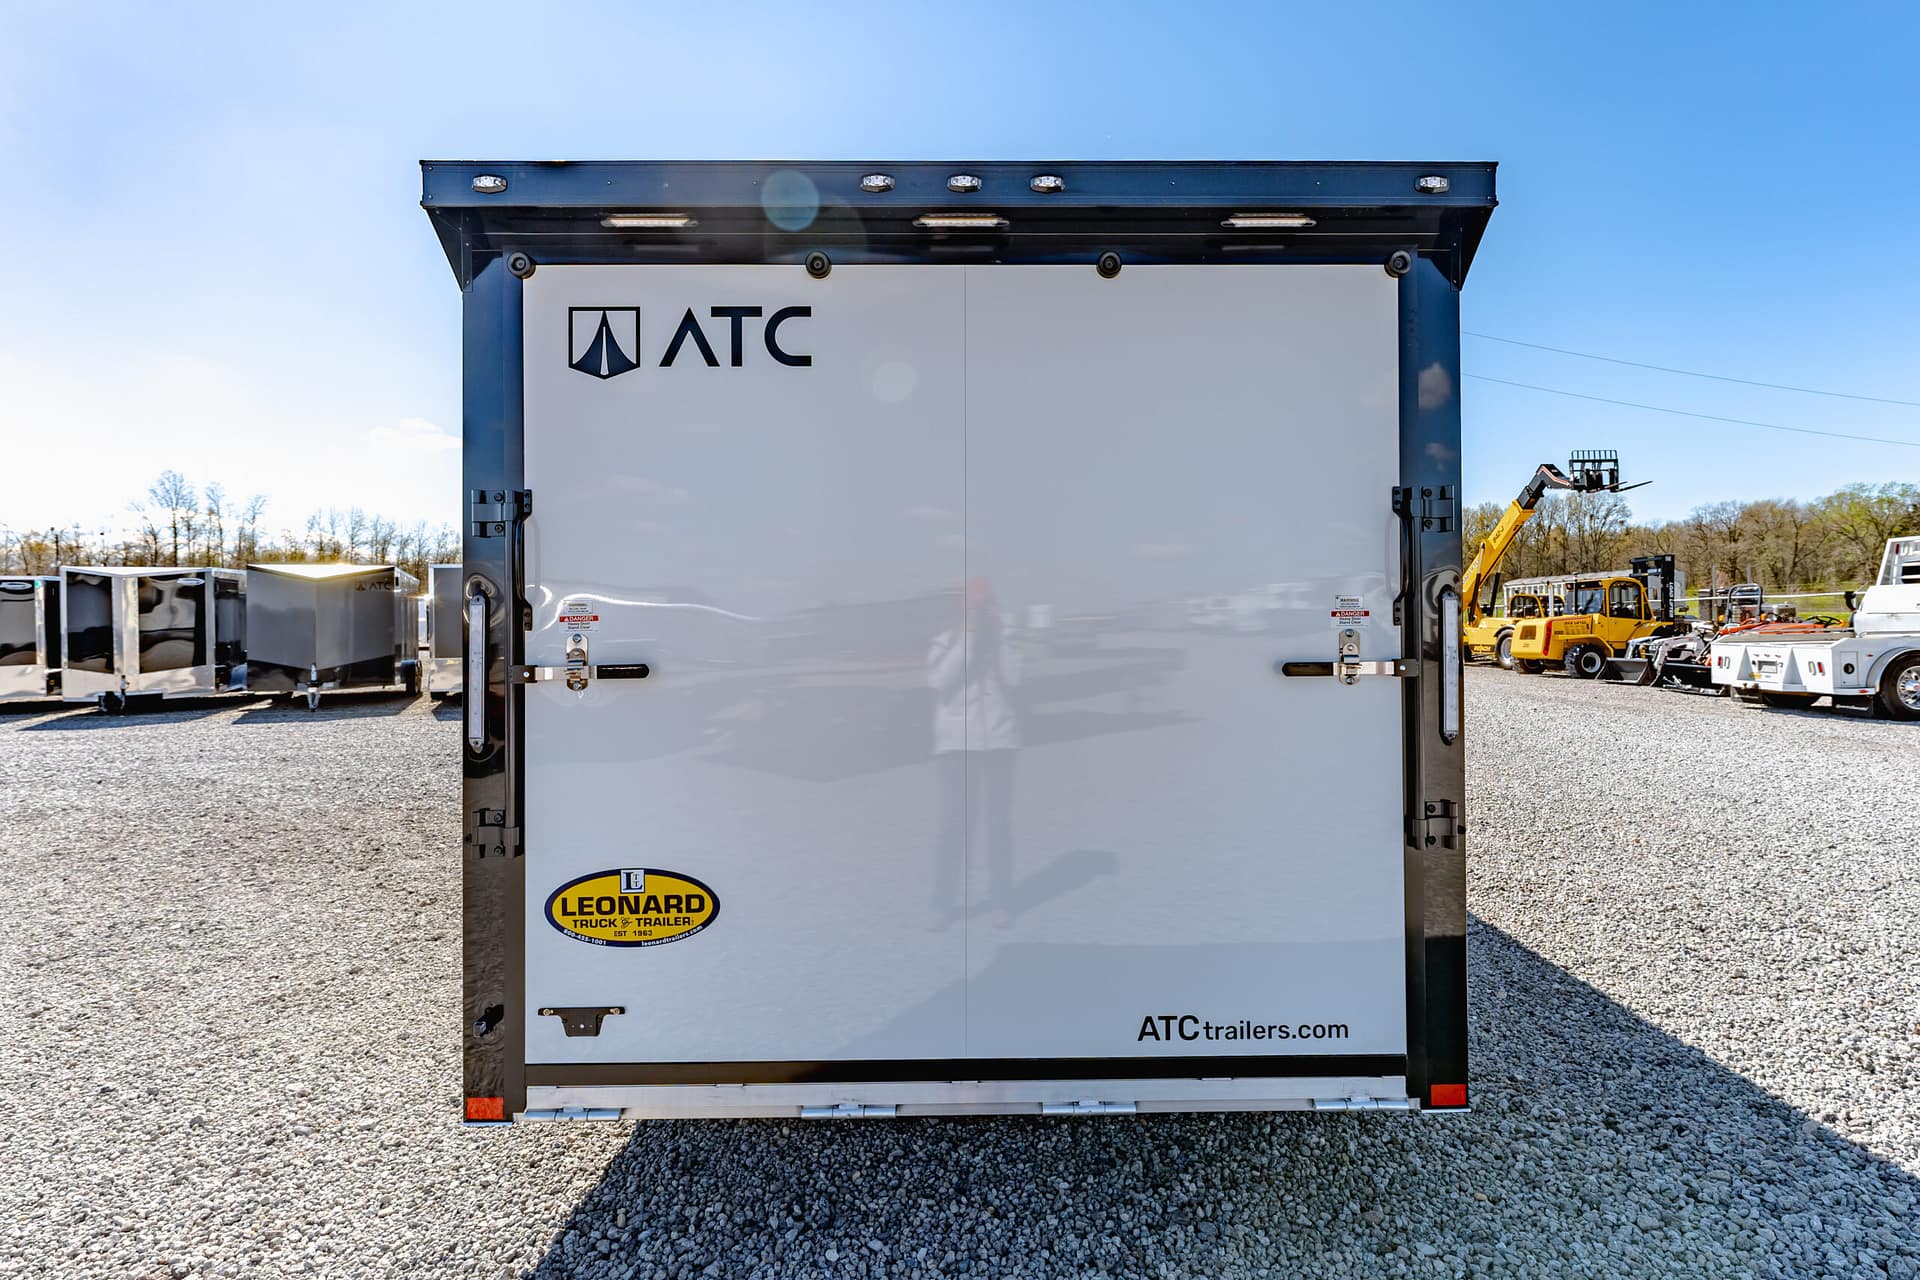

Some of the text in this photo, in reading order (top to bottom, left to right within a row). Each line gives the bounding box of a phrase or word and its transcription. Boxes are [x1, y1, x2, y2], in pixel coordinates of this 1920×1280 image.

[658, 305, 812, 367] ATC
[561, 894, 705, 917] LEONARD
[572, 918, 618, 929] TRUCK
[635, 917, 691, 928] TRAILER
